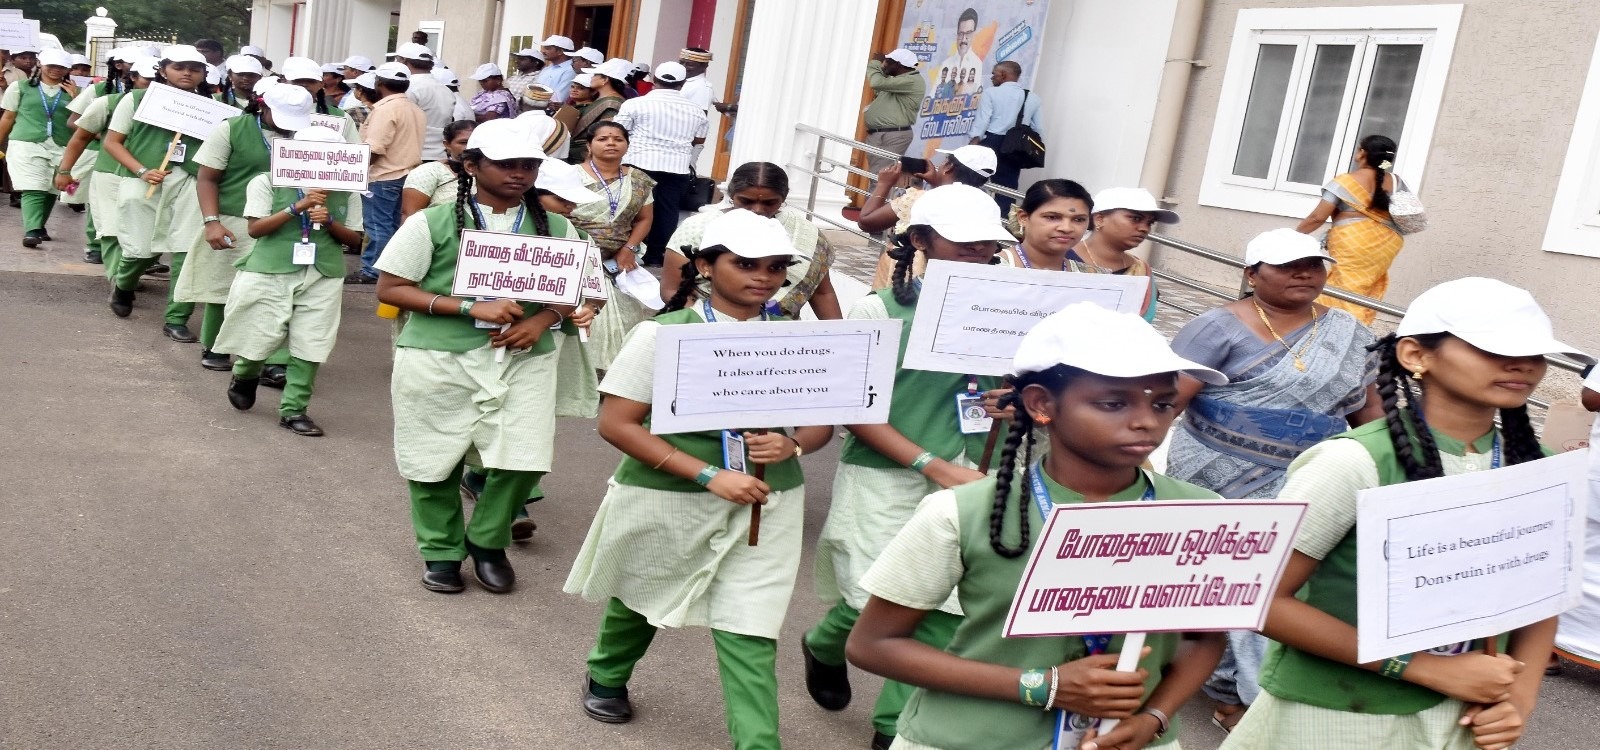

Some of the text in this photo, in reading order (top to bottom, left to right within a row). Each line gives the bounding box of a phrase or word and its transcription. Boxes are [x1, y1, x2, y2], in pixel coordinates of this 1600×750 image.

[280, 146, 363, 165] போதையை ஒழிக்கும்
[276, 168, 364, 183] பாதையை வளர்ப்போம்
[464, 240, 511, 264] போதை
[467, 270, 536, 292] நாட்டுக்கும்
[537, 275, 567, 296] கேடு
[712, 350, 751, 358] When
[754, 349, 778, 358] you
[780, 348, 796, 356] do
[718, 369, 728, 377] It
[730, 368, 754, 377] also
[756, 367, 798, 376] affects
[712, 386, 828, 397] who care about you
[1055, 522, 1279, 566] போதையை ஒழிக்கும்
[1406, 519, 1554, 559] Life is a beautiful journey
[1454, 566, 1485, 580] ruin
[1486, 563, 1497, 574] it
[1498, 556, 1522, 572] with
[1523, 550, 1550, 564] drugs
[1028, 573, 1262, 620] பாதையை வளர்ப்போம்
